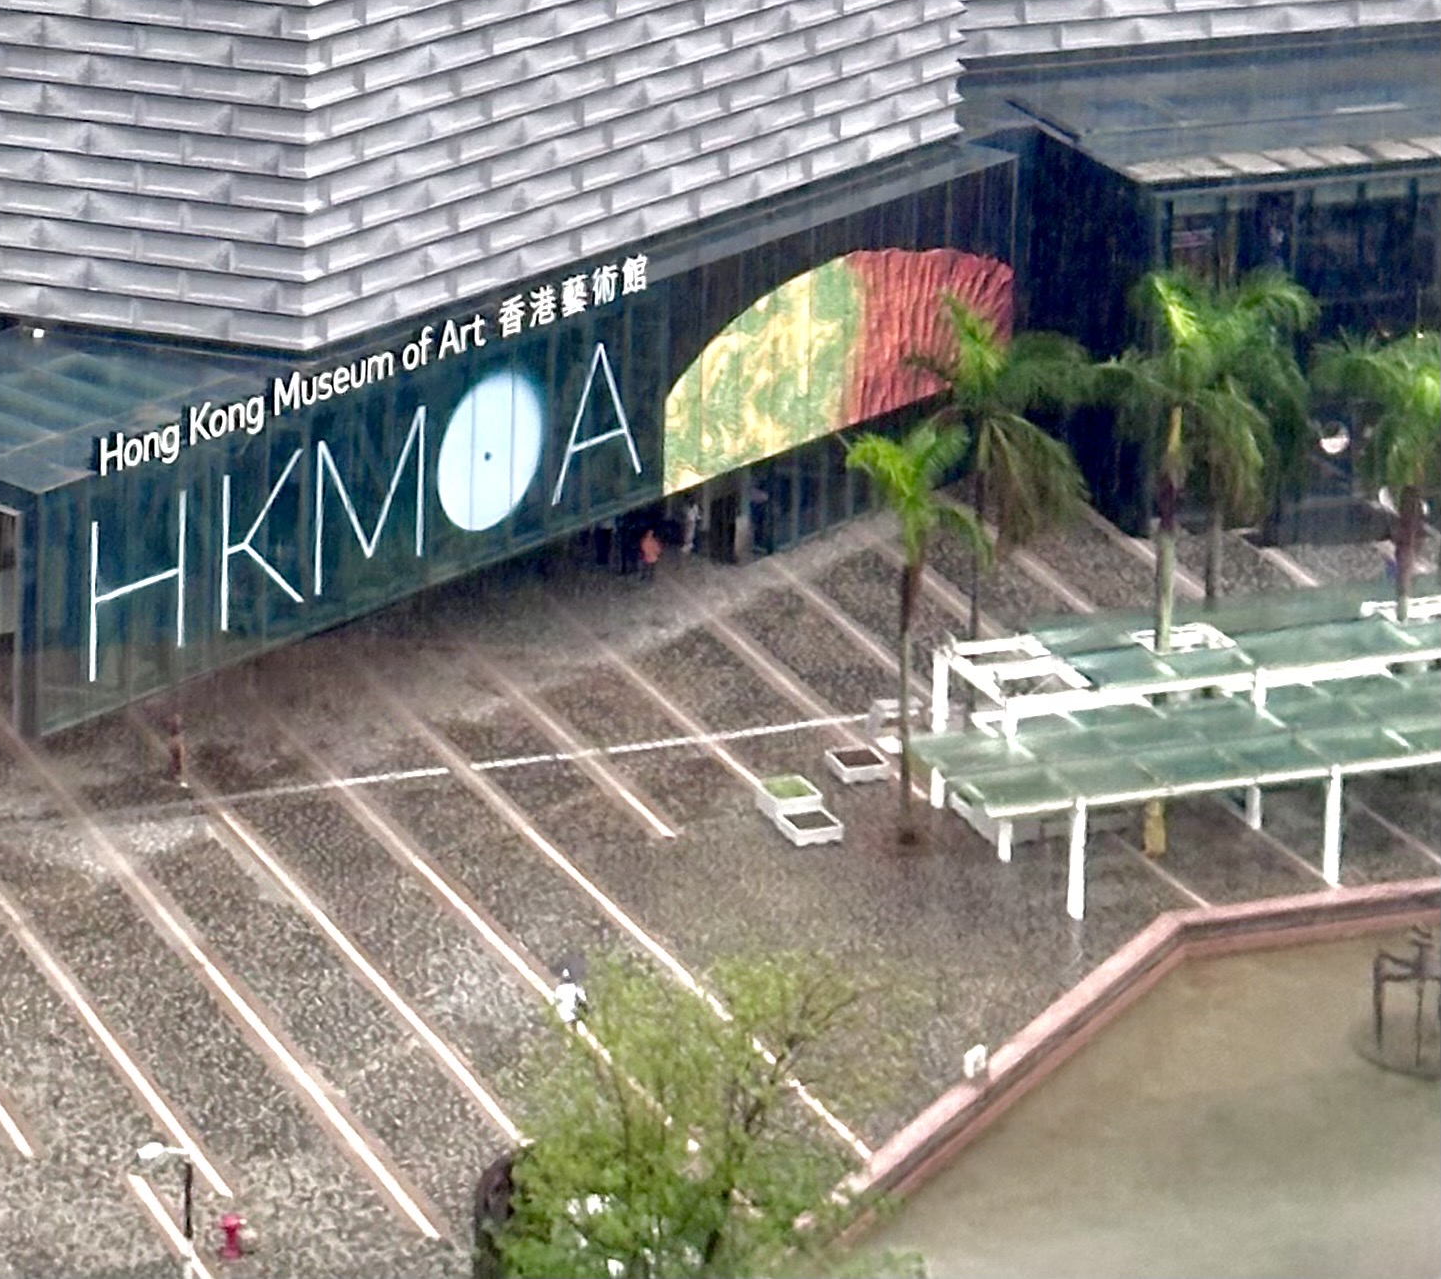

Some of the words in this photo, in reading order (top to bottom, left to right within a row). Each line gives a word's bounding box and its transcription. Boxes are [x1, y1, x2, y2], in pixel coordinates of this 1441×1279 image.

[99, 421, 180, 476] Hong
[188, 390, 264, 441] Kong
[273, 350, 394, 415] Museum
[402, 325, 432, 370] of
[438, 318, 486, 360] Art
[498, 253, 648, 338] 香港藝術館
[88, 342, 642, 682] HKMOA
